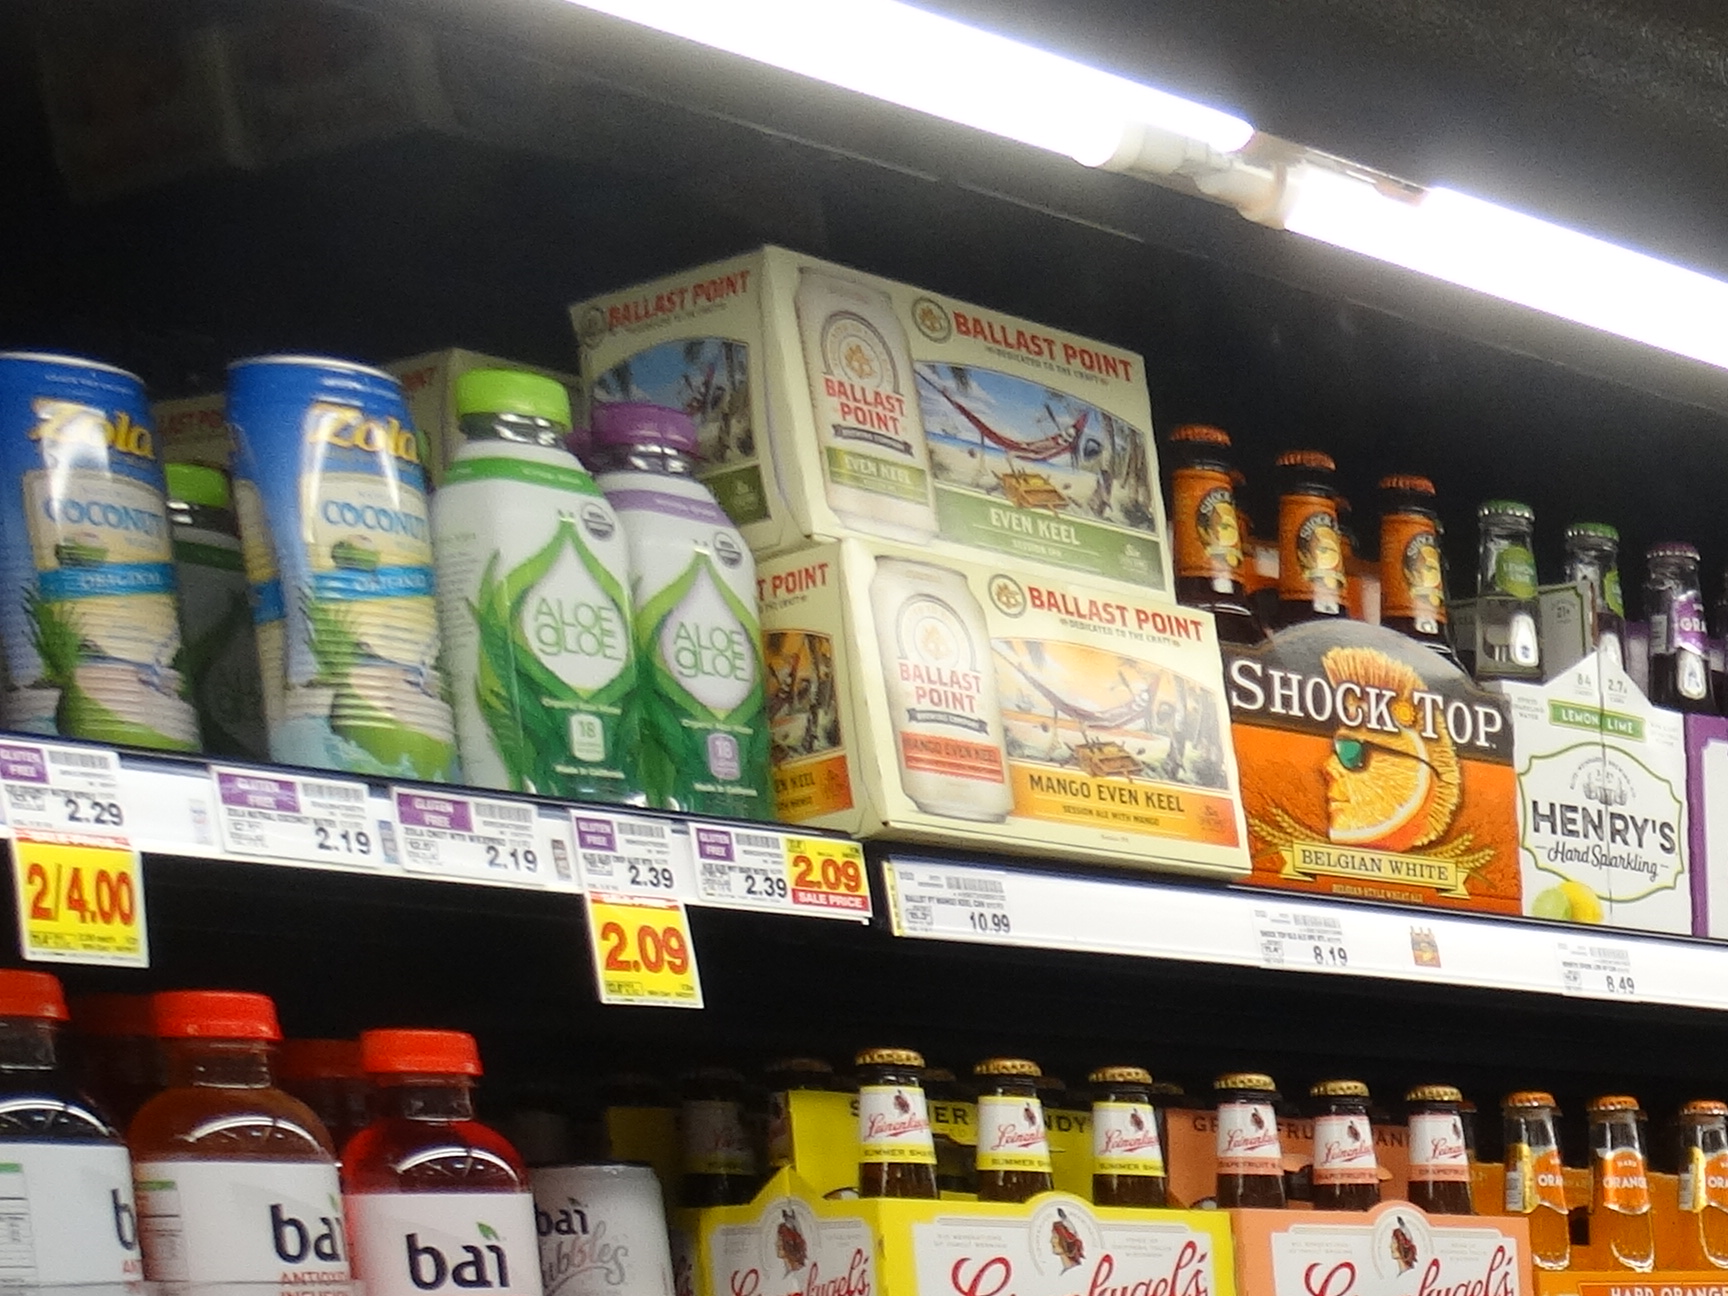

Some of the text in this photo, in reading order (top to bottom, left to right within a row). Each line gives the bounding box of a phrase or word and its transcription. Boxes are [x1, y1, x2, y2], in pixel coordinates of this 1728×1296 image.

[989, 509, 1081, 546] EVEN KEEL
[1027, 586, 1205, 644] BALLAST POINT
[1229, 659, 1503, 748] SHOCK TOP
[1559, 709, 1635, 734] LEMON LIME
[1029, 774, 1185, 814] MANGO EVEN KEEL
[64, 801, 125, 827] 2.29
[1530, 800, 1676, 854] HENRY'S
[315, 827, 372, 855] 2.19
[791, 858, 862, 891] 2.09
[1299, 847, 1450, 881] BELGIAN WHITE
[26, 862, 136, 923] 2/4.00
[968, 912, 1012, 934] 10.99
[602, 924, 689, 974] 2.09
[406, 1223, 513, 1291] bai
